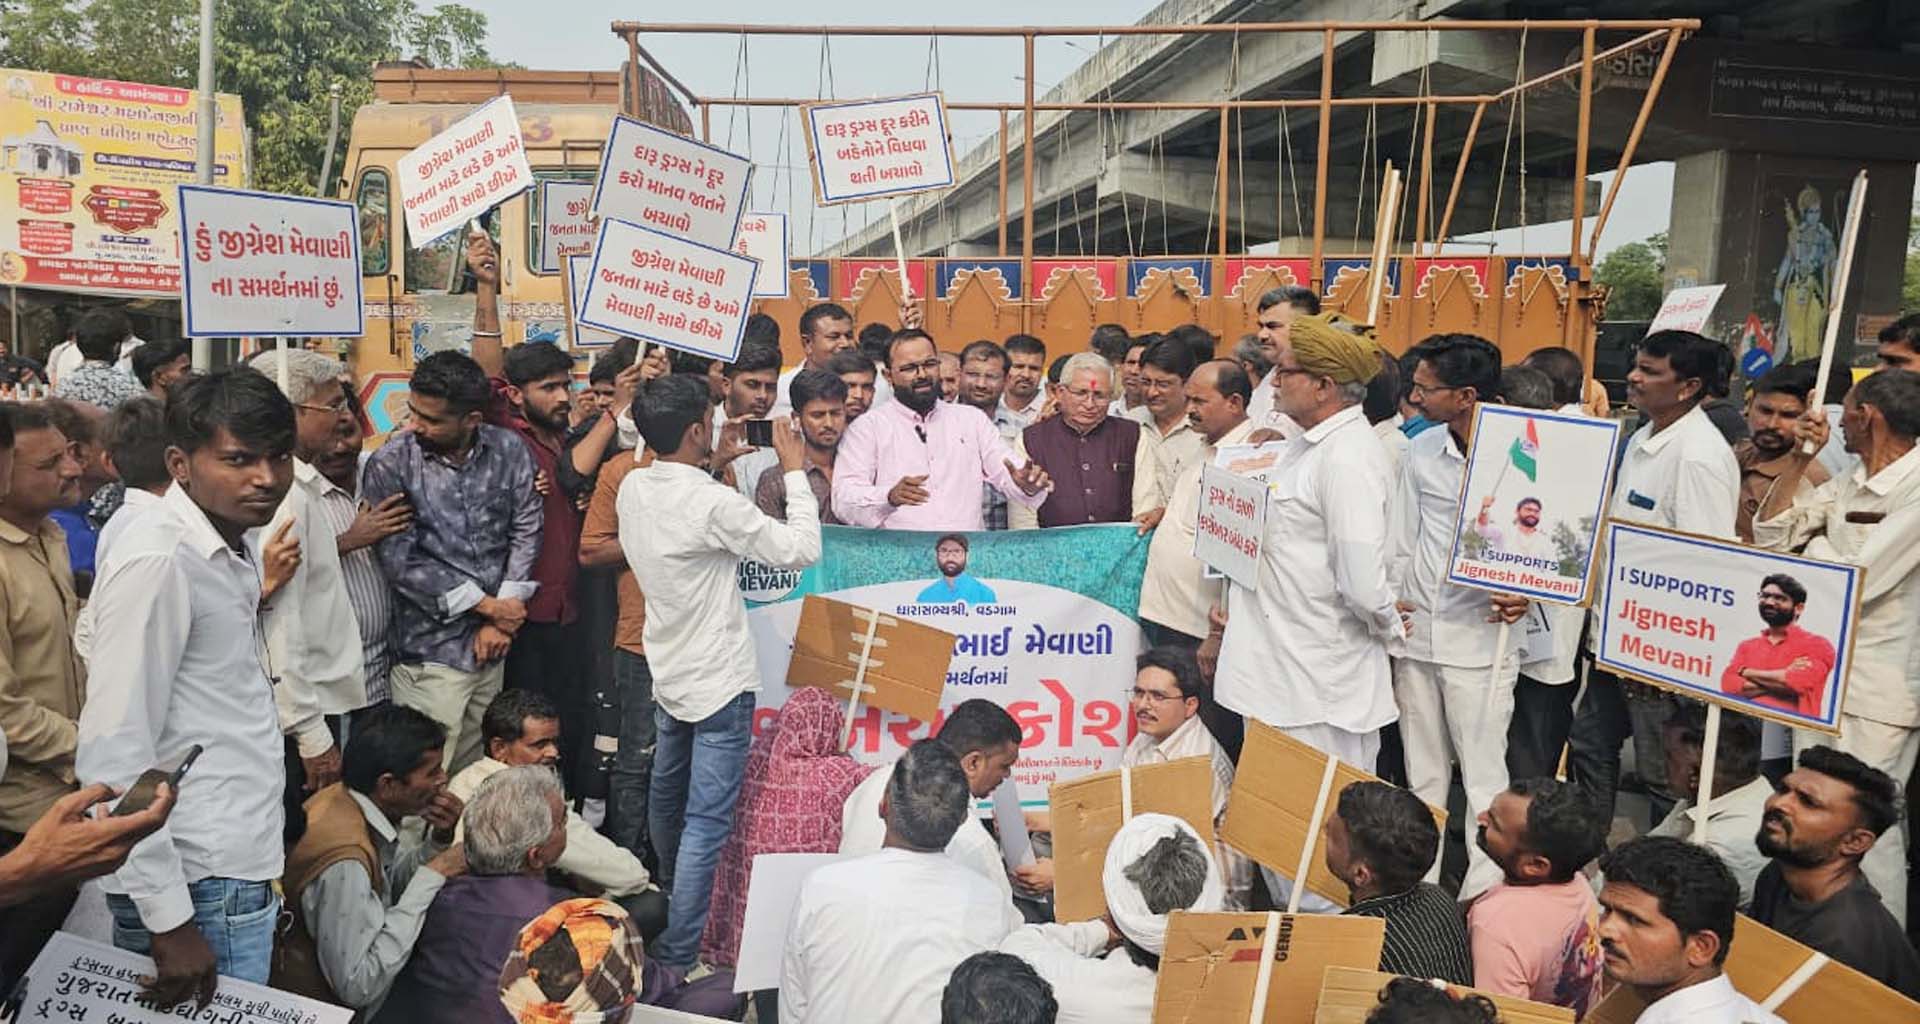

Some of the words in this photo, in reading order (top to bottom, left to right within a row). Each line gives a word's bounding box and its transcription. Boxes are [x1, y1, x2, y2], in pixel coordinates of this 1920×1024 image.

[455, 120, 494, 155] મેવાણી
[825, 123, 847, 138] દારૂ
[881, 117, 896, 136] દૂર
[899, 109, 930, 128] કરીને
[837, 140, 884, 161] બહેનોને
[887, 136, 927, 155] વિધવા
[405, 186, 437, 209] જનતા
[439, 169, 461, 191] માટે
[462, 158, 481, 179] લડે
[483, 150, 494, 167] છે
[496, 135, 520, 159] અમે
[634, 145, 659, 167] દારૂ
[695, 159, 705, 178] ને
[707, 168, 724, 190] દૂર
[850, 165, 876, 184] થતી
[880, 160, 923, 180] બચાવો
[419, 196, 459, 229] મેવાણી
[462, 182, 487, 207] સાથે
[488, 165, 518, 193] છીએ
[618, 169, 644, 189] કરો
[647, 178, 685, 202] માનવ
[689, 191, 726, 214] જાતને
[550, 223, 577, 236] જનતા
[643, 206, 691, 232] બચાવો
[195, 222, 212, 262] હું
[218, 222, 284, 259] જીગ્નેશ
[289, 227, 352, 260] મેવાણી
[211, 277, 232, 298] ના
[238, 270, 319, 299] સમર્થનમાં
[324, 275, 344, 308] છું.
[678, 257, 726, 287] મેવાણી
[601, 268, 641, 290] જનતા
[643, 280, 670, 298] માટે
[673, 286, 694, 306] લડે
[698, 292, 711, 309] છે
[714, 299, 740, 318] અમે
[606, 293, 655, 322] મેવાણી
[657, 311, 687, 330] સાથે
[689, 317, 723, 340] છીએ
[1456, 561, 1516, 583] Jignesh
[1520, 573, 1579, 593] Mevani
[1488, 550, 1559, 571] SUPPORTS
[1620, 566, 1625, 581] I
[1629, 568, 1735, 607] SUPPORTS
[896, 602, 969, 618] ધારાસભ્યશ્રી,
[976, 604, 1017, 617] વડગામ
[1618, 599, 1716, 641] Jignesh
[952, 626, 1013, 657] ભાઈ
[1025, 623, 1113, 656] મેવાણી
[1620, 634, 1712, 677] Mevani
[945, 666, 1009, 687] મર્થનમાં
[1275, 914, 1294, 962] GENUI
